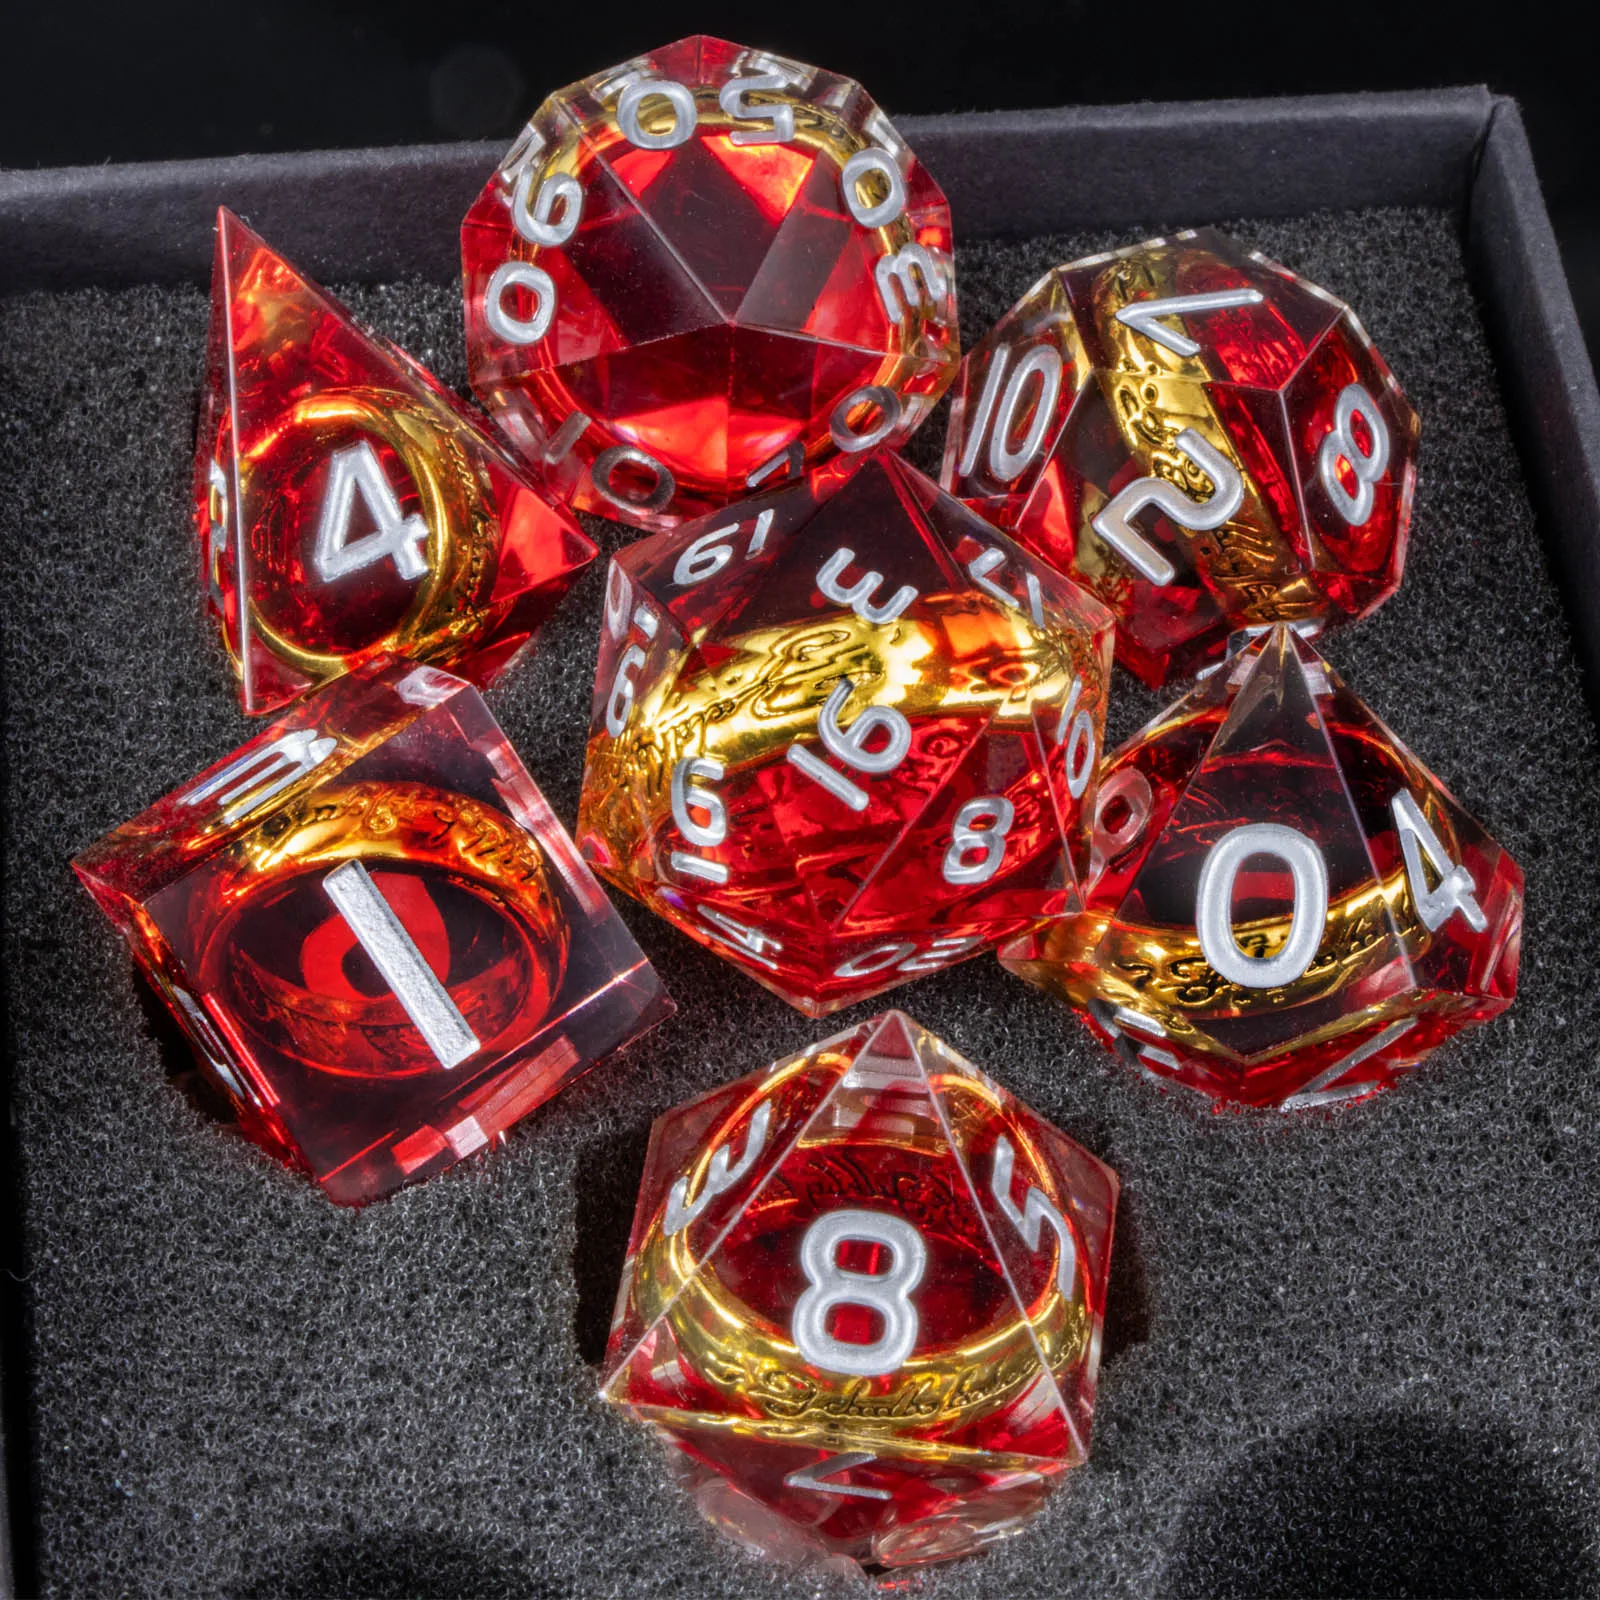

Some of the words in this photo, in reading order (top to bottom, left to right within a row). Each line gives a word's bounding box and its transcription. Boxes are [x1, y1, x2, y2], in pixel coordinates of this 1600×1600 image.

[1115, 288, 1263, 357] 7
[959, 343, 1062, 482] 10
[1320, 384, 1389, 526] 8
[314, 440, 429, 582] 4
[1092, 427, 1244, 586] 2
[816, 547, 918, 624] 3
[787, 679, 911, 811] 16
[1058, 675, 1095, 799] 10
[943, 797, 1014, 884] 8
[1196, 823, 1329, 988] 0
[1391, 788, 1488, 932] 4
[322, 859, 481, 1070] 1
[664, 1100, 771, 1235] 3
[993, 1135, 1076, 1300] 5
[792, 1210, 925, 1375] 8
